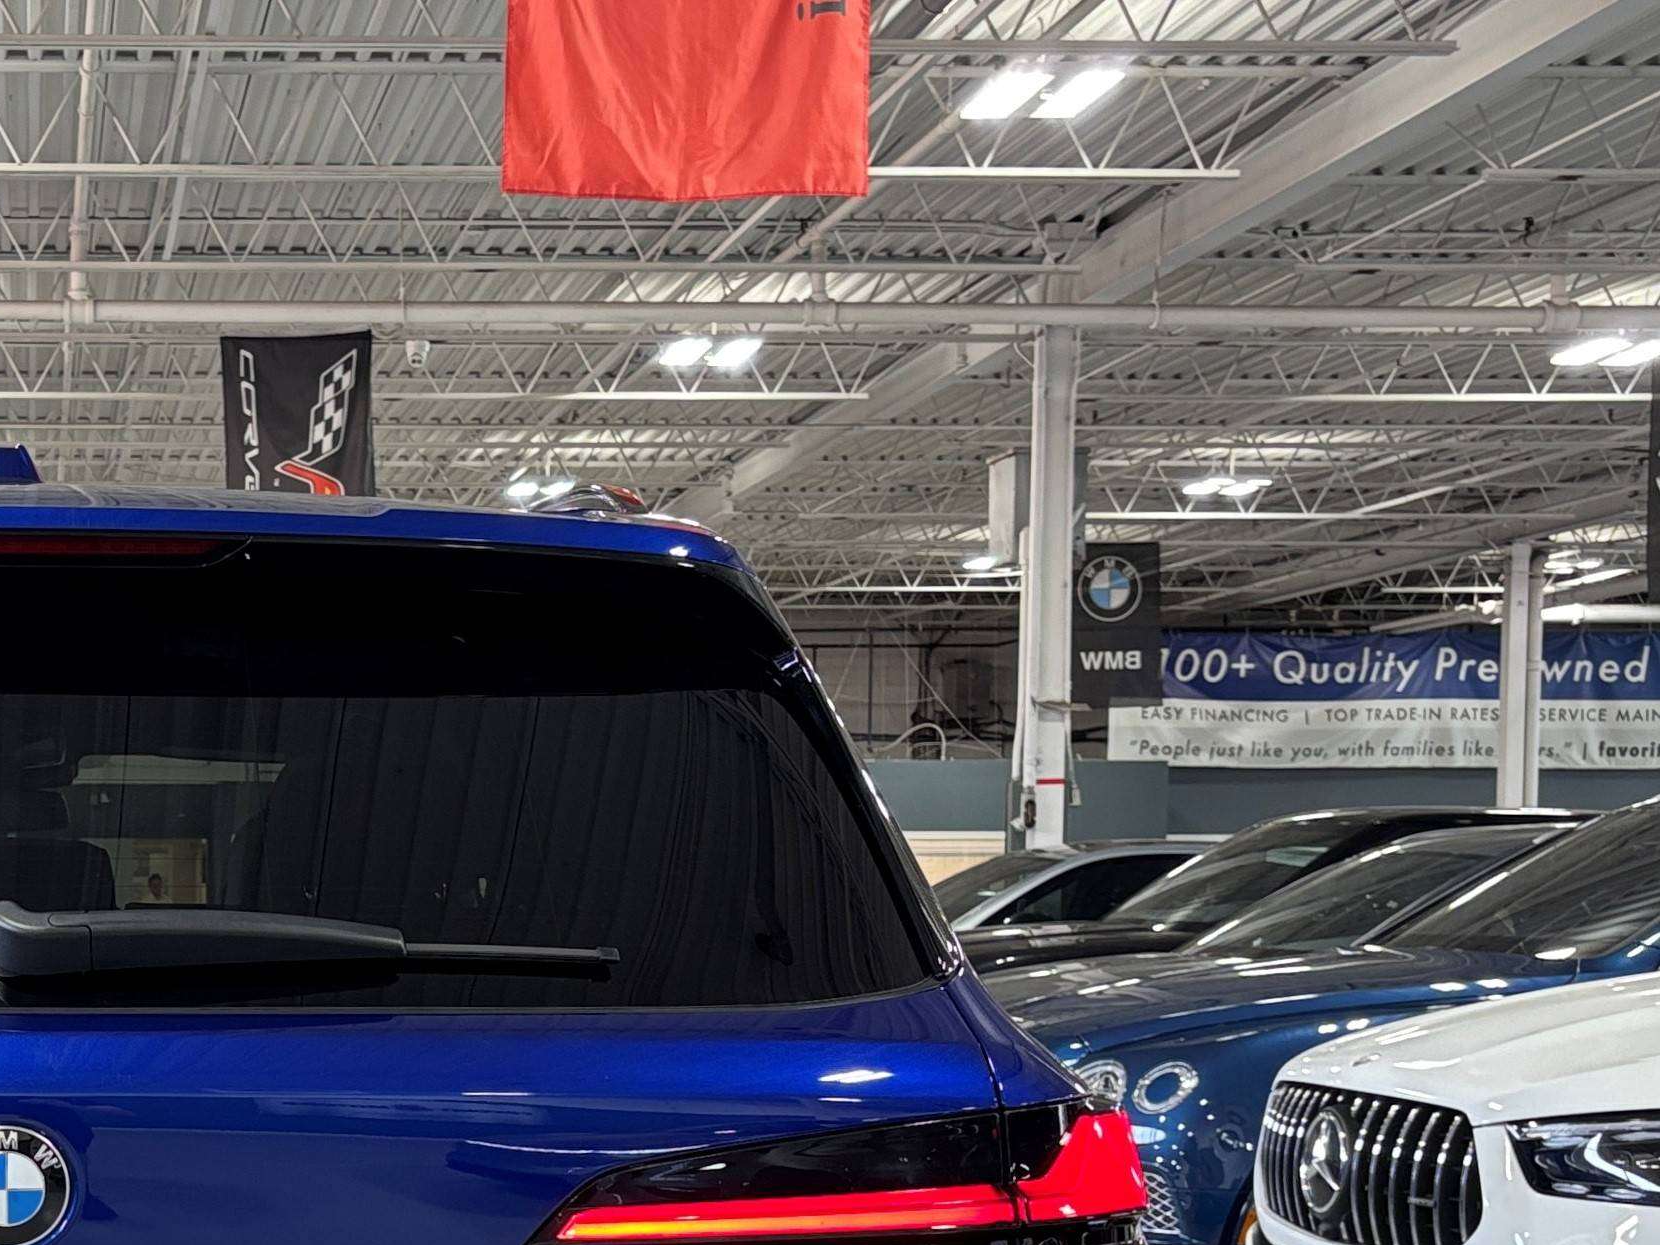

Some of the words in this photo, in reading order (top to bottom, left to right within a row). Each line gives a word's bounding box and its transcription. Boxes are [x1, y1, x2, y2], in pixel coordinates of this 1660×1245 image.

[1272, 646, 1421, 694] Quality
[1434, 646, 1500, 683] Pre
[1538, 645, 1651, 683] wned
[1140, 707, 1184, 721] EASY
[1190, 708, 1290, 723] FINANCING
[1324, 708, 1358, 723] TOP
[1366, 706, 1442, 722] TRADE-IN
[1450, 707, 1501, 722] RATES
[1539, 707, 1608, 722] SERVICE
[1208, 740, 1244, 761] just
[1250, 740, 1284, 758] like
[1291, 744, 1328, 762] you,
[1337, 740, 1375, 758] with
[1382, 739, 1455, 758] families
[1461, 740, 1495, 757] like
